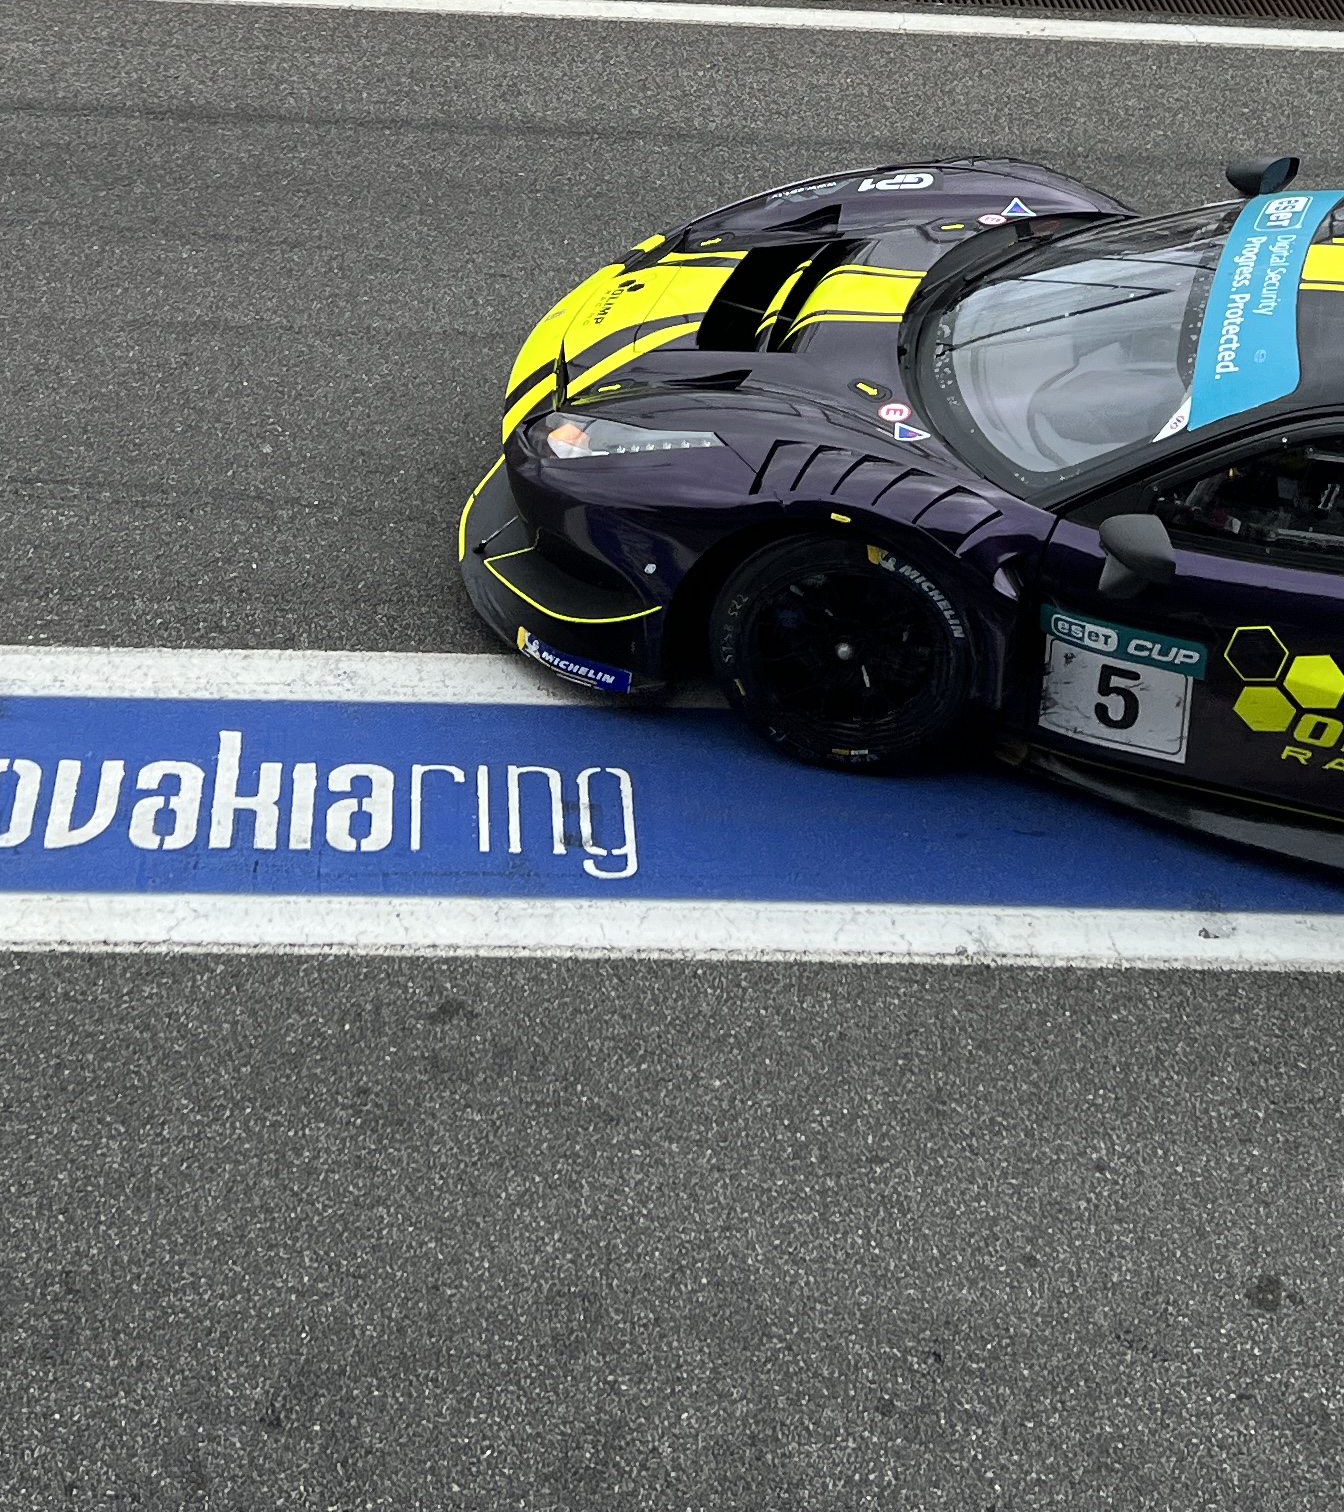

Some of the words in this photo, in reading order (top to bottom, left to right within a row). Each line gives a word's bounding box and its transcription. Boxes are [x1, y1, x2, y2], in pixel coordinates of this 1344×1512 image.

[857, 172, 935, 192] GP1
[1232, 236, 1268, 291] Progress.
[1269, 234, 1297, 267] Digital
[594, 289, 624, 324] OLIMP
[1253, 267, 1287, 317] Security
[1214, 293, 1251, 380] Protected.
[898, 564, 965, 638] MICHELIN
[542, 650, 615, 684] MICHELIN
[1126, 639, 1200, 666] CUP
[1093, 663, 1142, 730] 5
